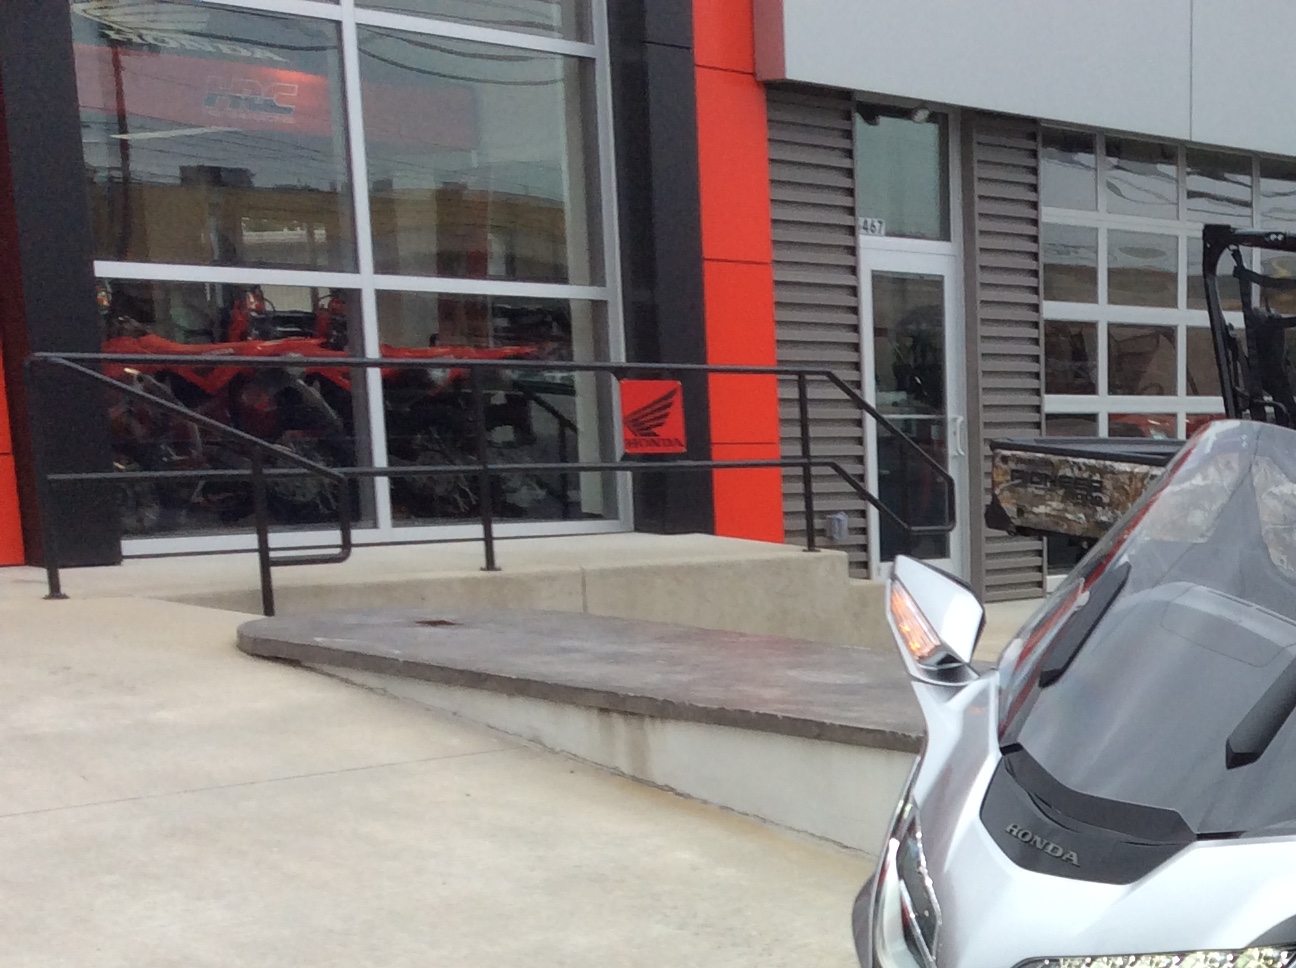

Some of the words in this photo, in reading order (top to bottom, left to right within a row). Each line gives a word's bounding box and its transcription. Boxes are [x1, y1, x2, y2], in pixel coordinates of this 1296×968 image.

[862, 219, 883, 234] 467
[624, 438, 685, 449] HONDA
[1004, 822, 1081, 868] HONDA
